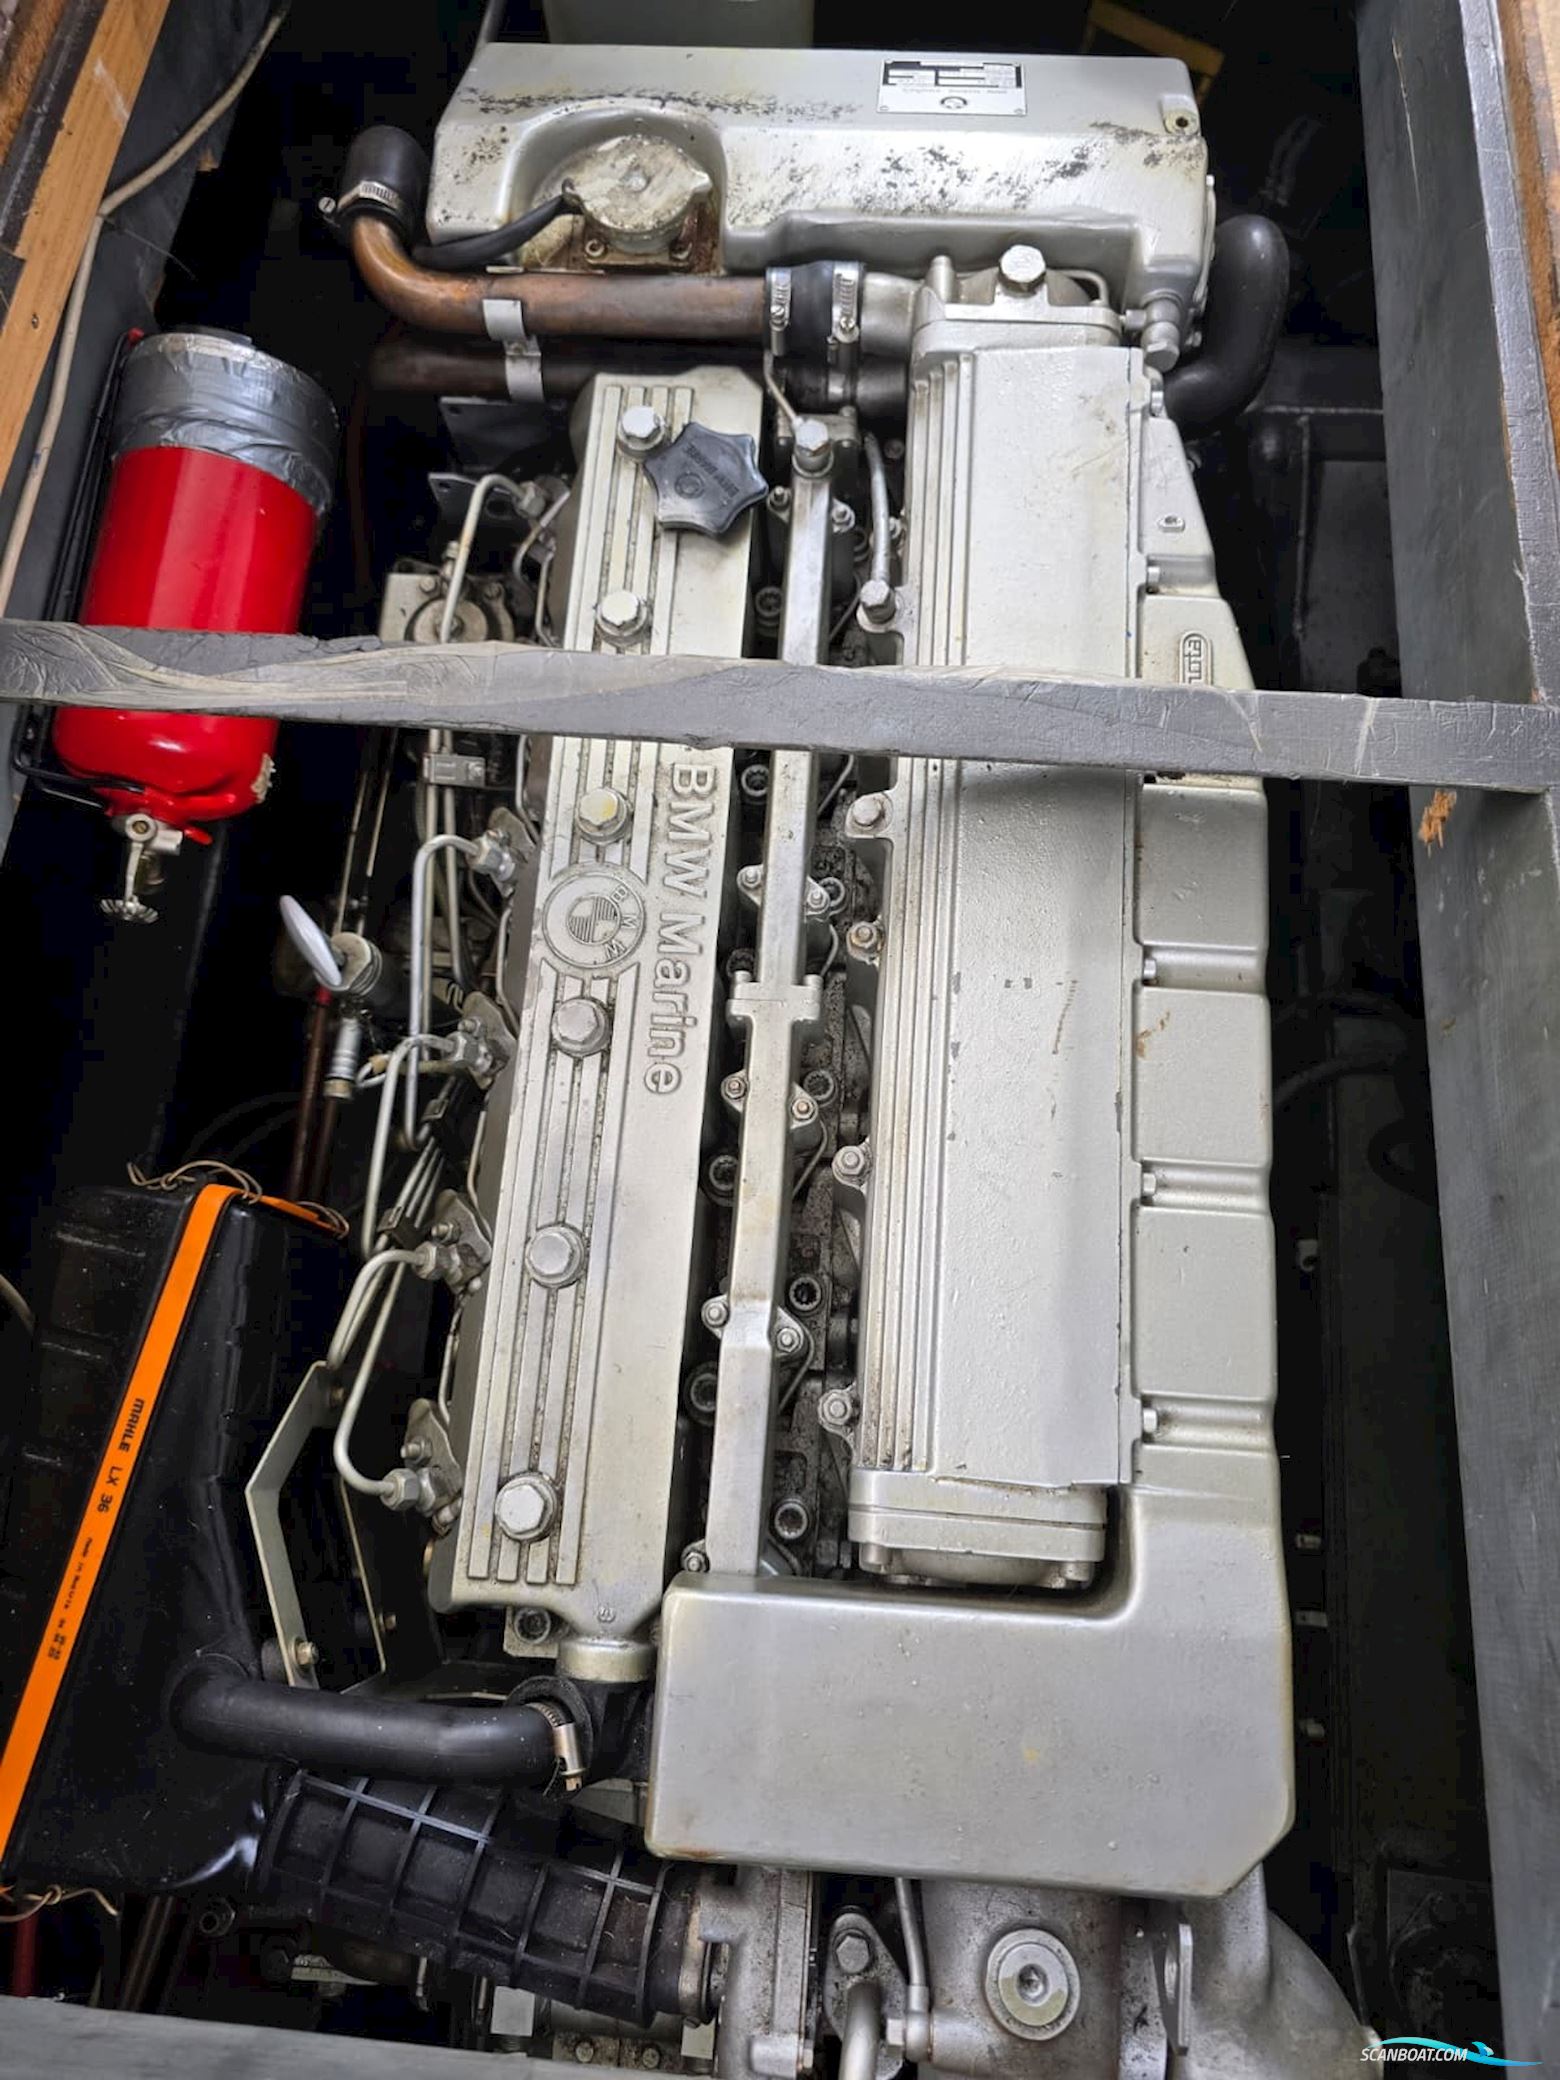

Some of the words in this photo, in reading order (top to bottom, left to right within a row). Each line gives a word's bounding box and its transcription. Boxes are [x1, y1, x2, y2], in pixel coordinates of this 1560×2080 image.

[663, 763, 717, 899] BMW
[604, 885, 638, 963] BMW
[644, 912, 706, 1095] Marine
[118, 1398, 145, 1453] MAHLE
[97, 1495, 113, 1513] 36
[105, 1465, 122, 1486] LX
